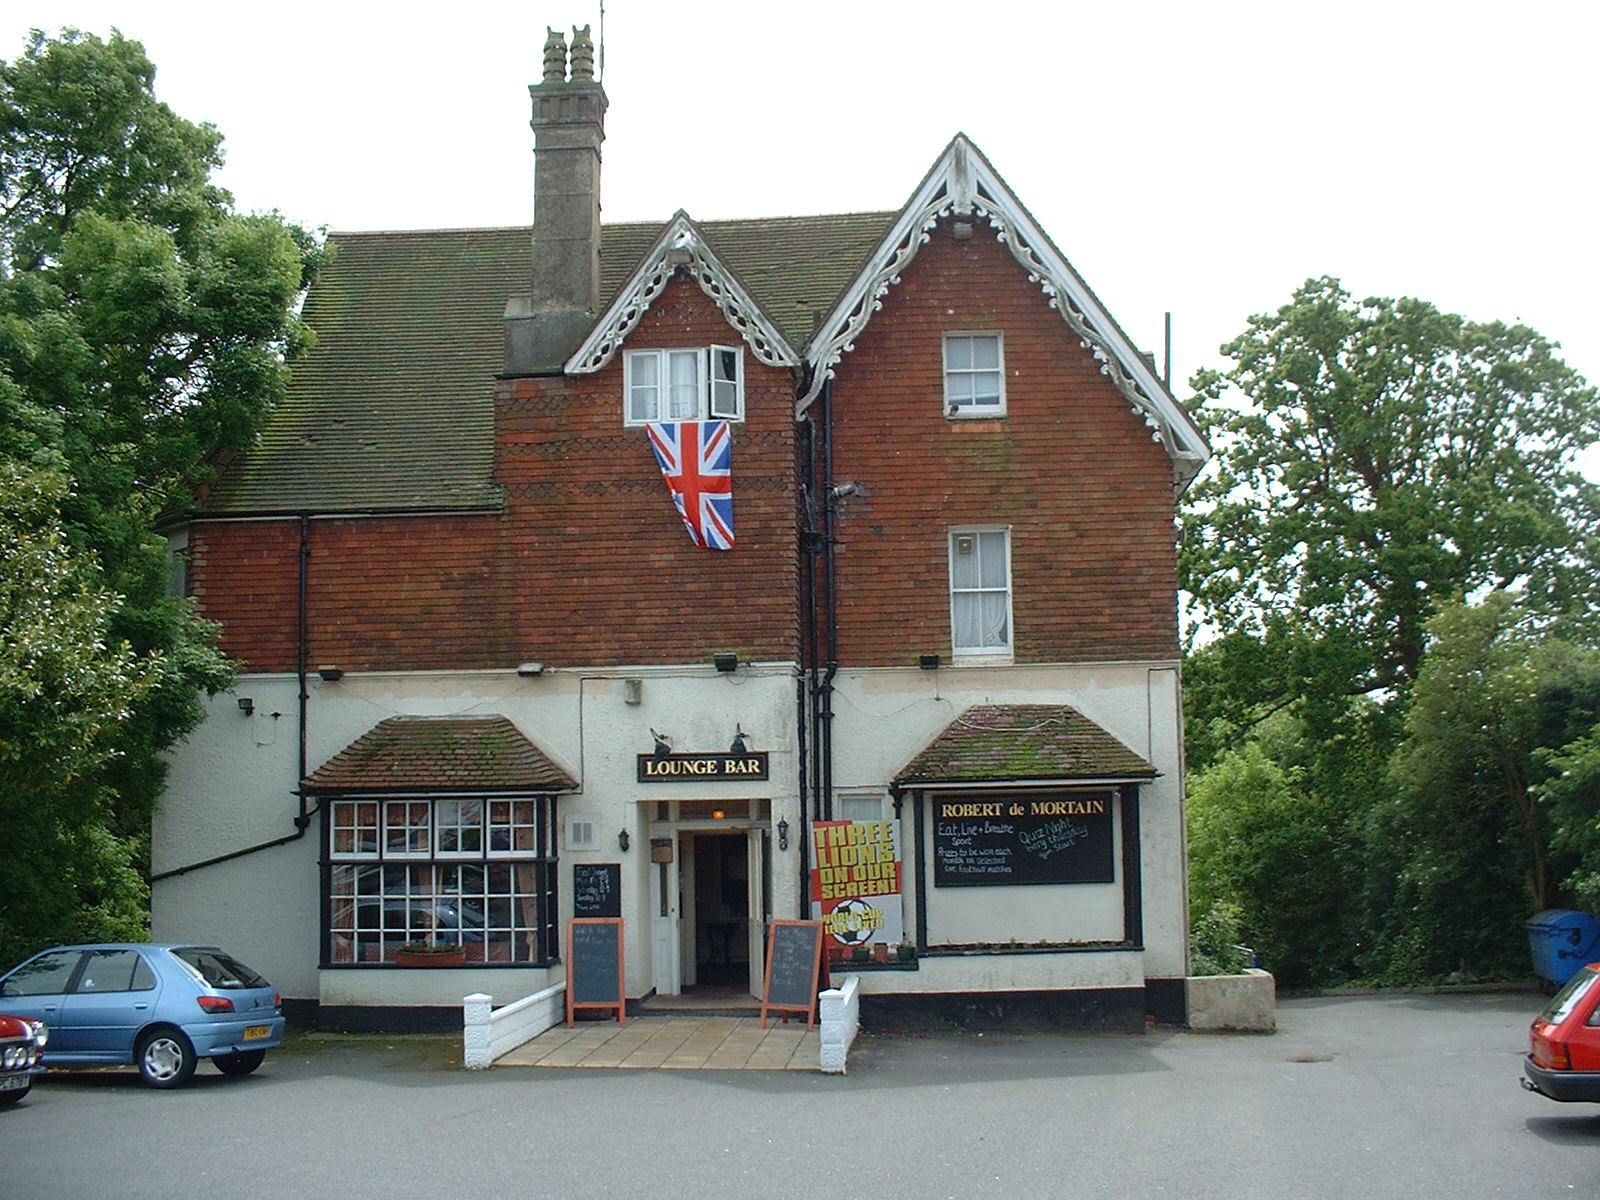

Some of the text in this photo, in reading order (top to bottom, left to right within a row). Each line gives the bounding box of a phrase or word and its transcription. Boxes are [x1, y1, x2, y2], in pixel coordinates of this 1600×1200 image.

[646, 759, 761, 775] LOUNGE BAR
[942, 801, 1104, 817] ROBERT de MORTAIN
[814, 821, 893, 848] THREE
[938, 822, 960, 837] Eat,
[961, 822, 977, 836] Live
[1019, 817, 1073, 844] Quiz Night
[817, 842, 895, 868] LIONS
[821, 862, 897, 884] ON OUR
[822, 879, 898, 899] SCREEN!
[862, 908, 884, 921] CUP
